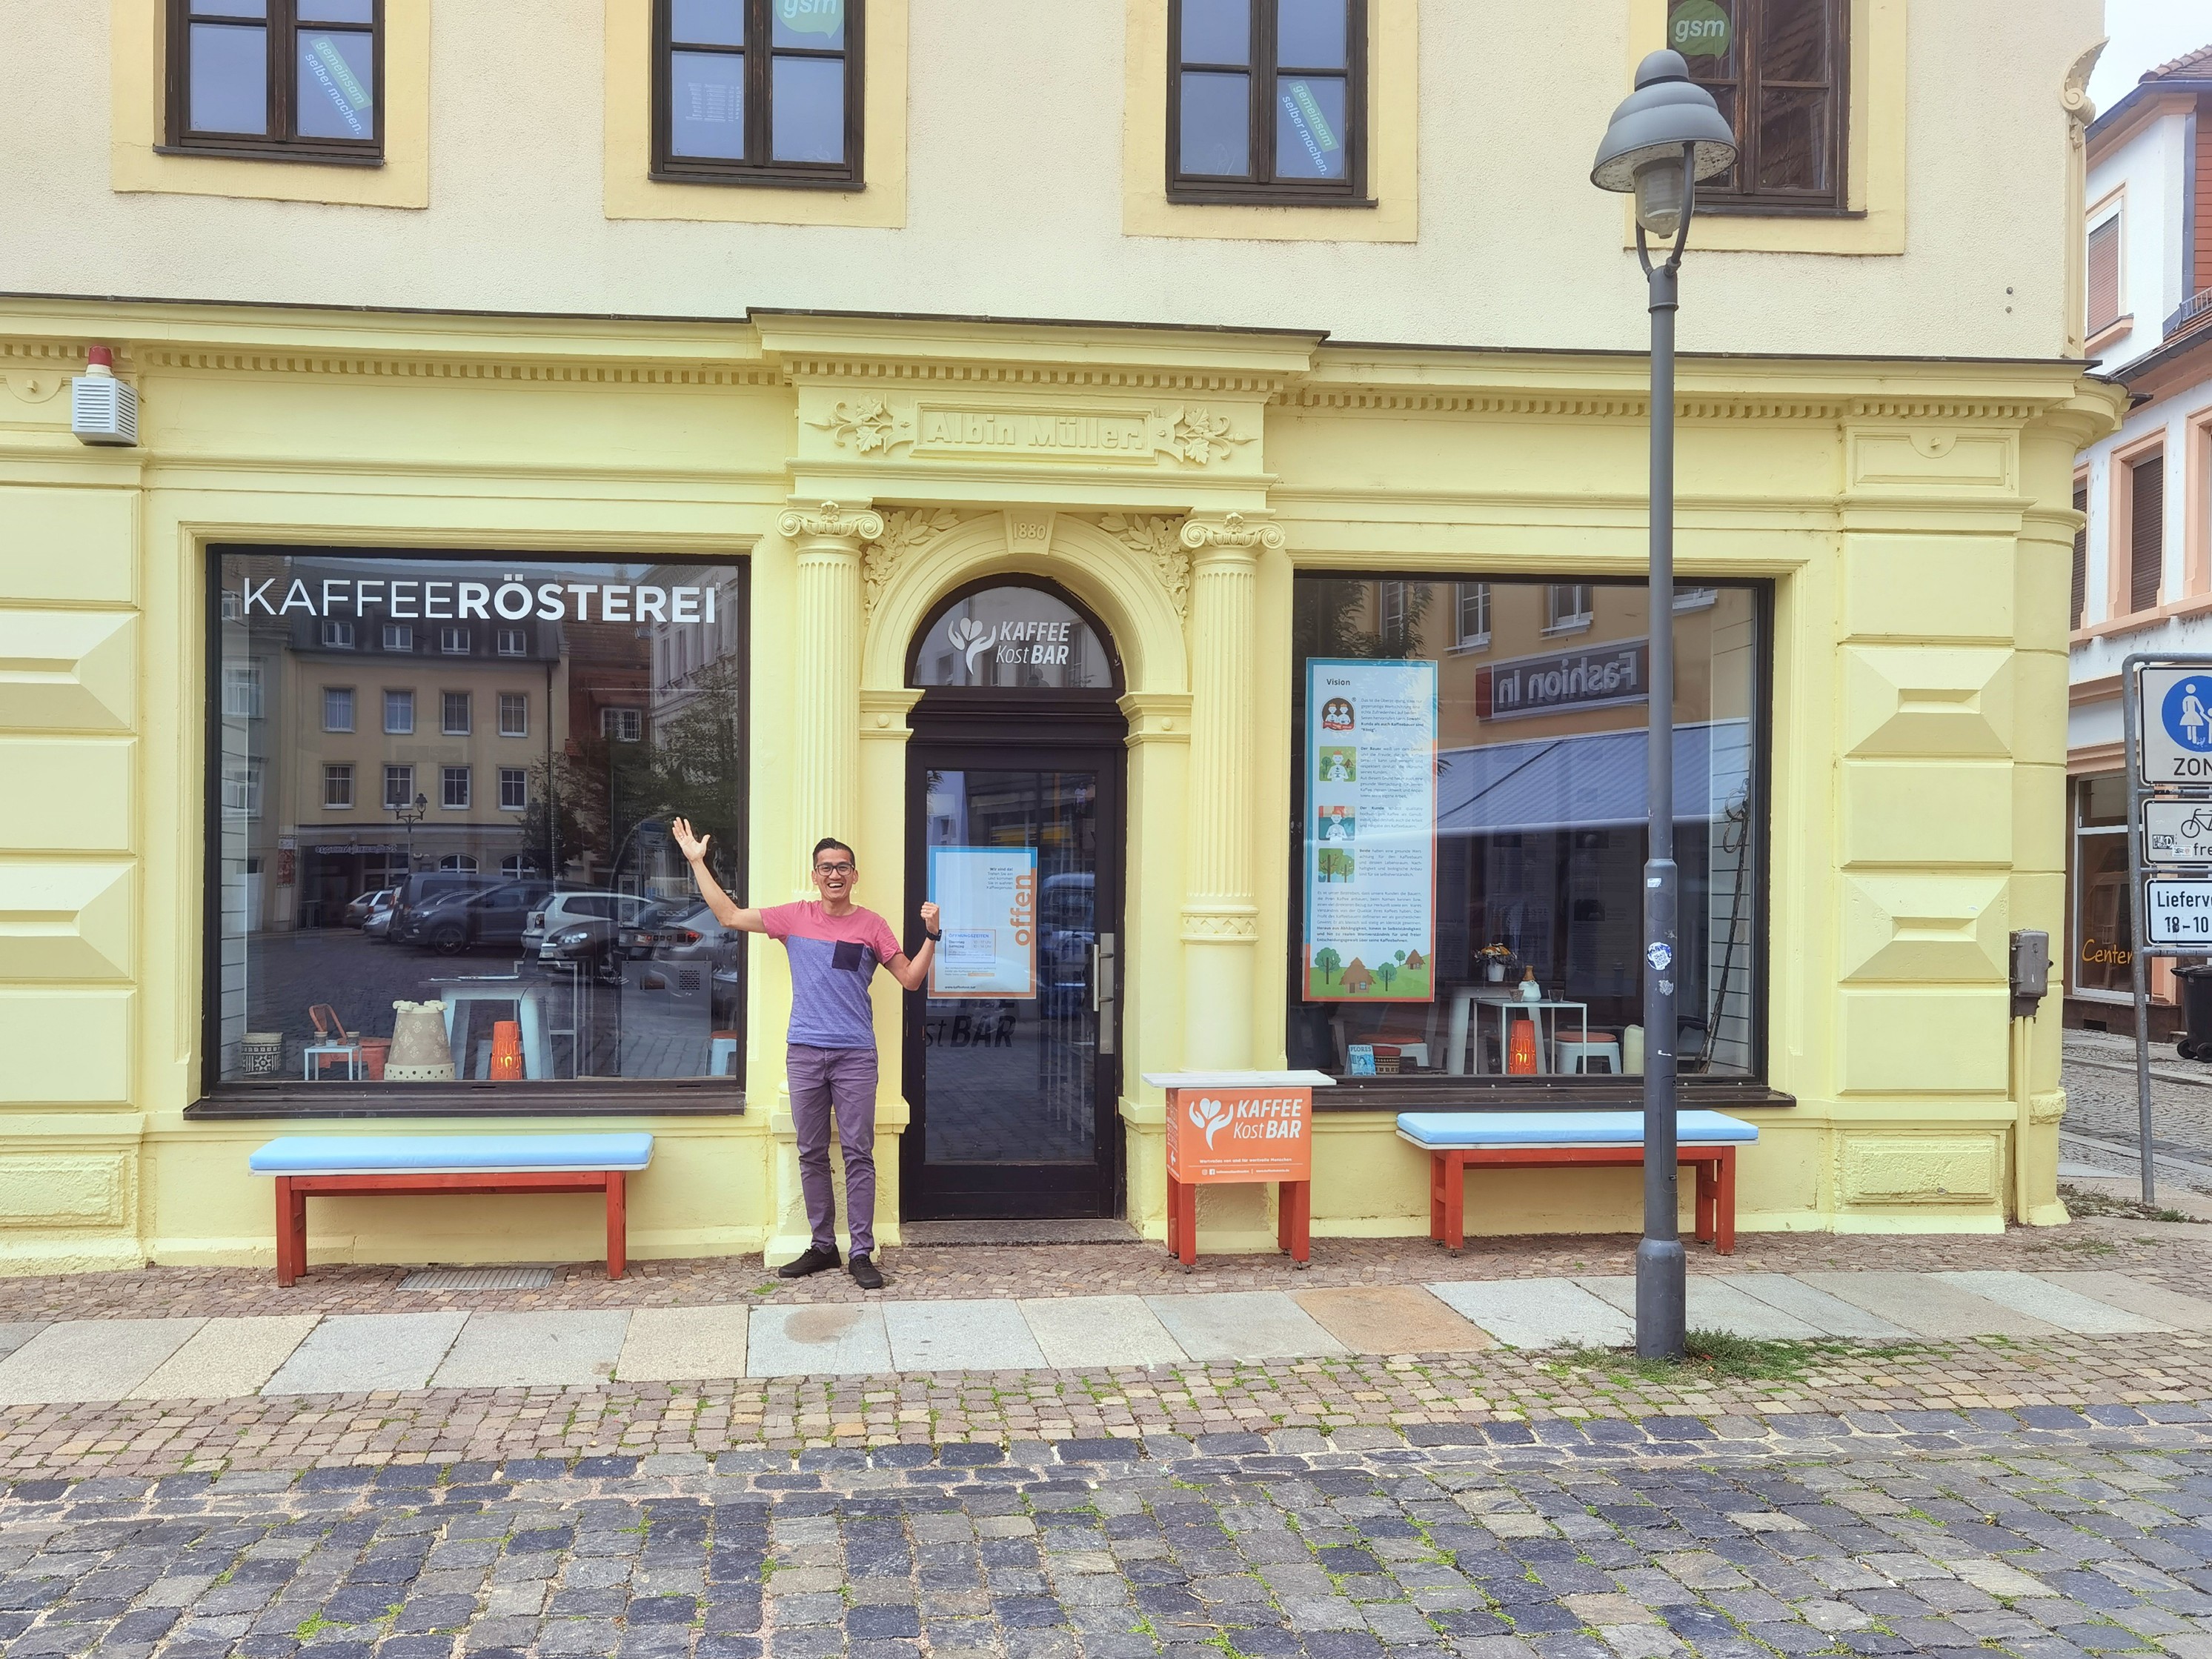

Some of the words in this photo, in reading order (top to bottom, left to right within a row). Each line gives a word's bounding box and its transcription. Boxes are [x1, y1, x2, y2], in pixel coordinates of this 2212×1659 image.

[784, 0, 837, 18] gsm
[1675, 20, 1725, 42] gsm
[316, 41, 365, 104] gemeinsam
[305, 53, 333, 86] selber
[328, 87, 362, 134] machen.
[1293, 85, 1332, 146] gemeinsam
[1282, 96, 1305, 127] selber
[1300, 129, 1328, 175] machen.
[926, 411, 1016, 445] Albin
[1013, 522, 1047, 539] 1880
[243, 573, 716, 624] KAFFEERÖSTEREI
[1000, 621, 1071, 642] KAFFEE
[995, 645, 1029, 664] Kost
[1030, 645, 1069, 665] BAR
[1326, 678, 1351, 686] Vision
[2173, 758, 2212, 776] ZON
[1010, 874, 1032, 946] offen
[2157, 891, 2212, 907] Lieferv
[2082, 939, 2133, 964] Center
[950, 1015, 1017, 1048] BAR
[1236, 1099, 1303, 1118] KAFFEE
[1233, 1122, 1264, 1139] Kost
[1266, 1120, 1302, 1139] BAR
